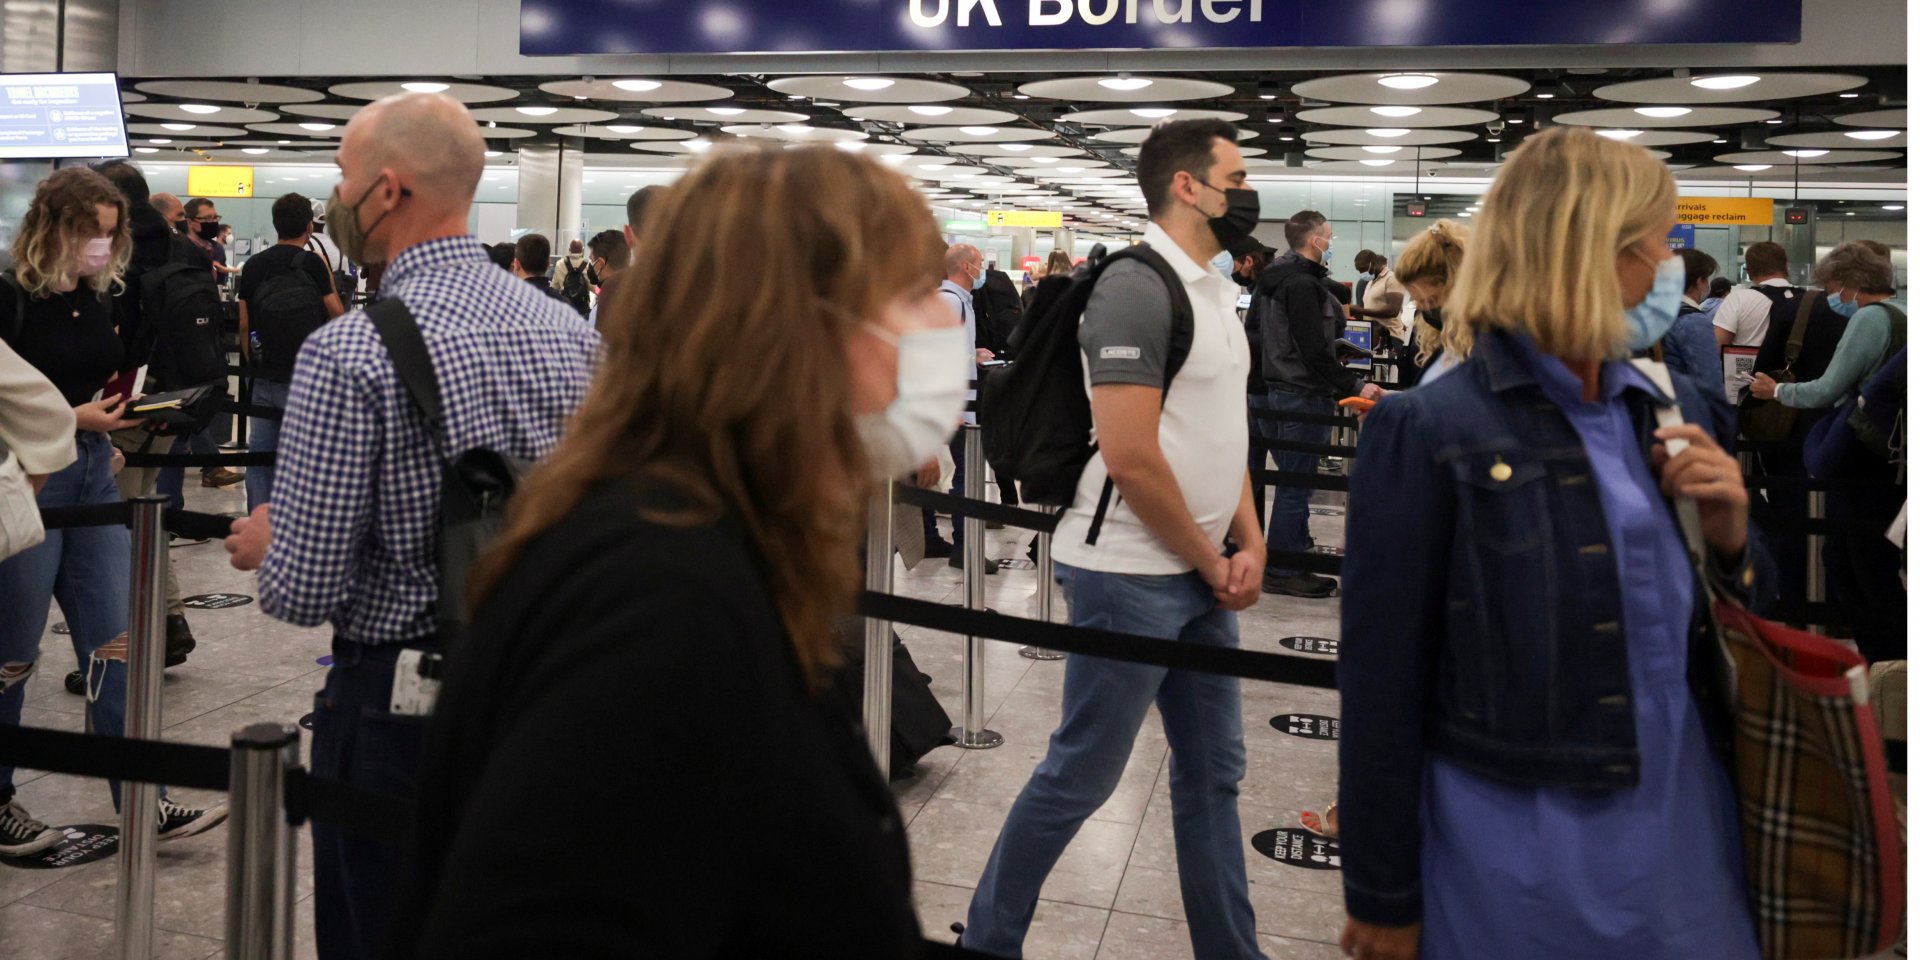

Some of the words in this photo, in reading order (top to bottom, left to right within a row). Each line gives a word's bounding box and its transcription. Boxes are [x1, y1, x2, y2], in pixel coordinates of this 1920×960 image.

[909, 0, 1003, 28] UK
[1676, 203, 1706, 211] rrivals
[1677, 213, 1710, 221] ggage
[1712, 213, 1746, 221] reclaim
[1275, 830, 1288, 845] YOUR
[1274, 845, 1286, 859] KEEP
[1290, 833, 1304, 860] DISTANCE
